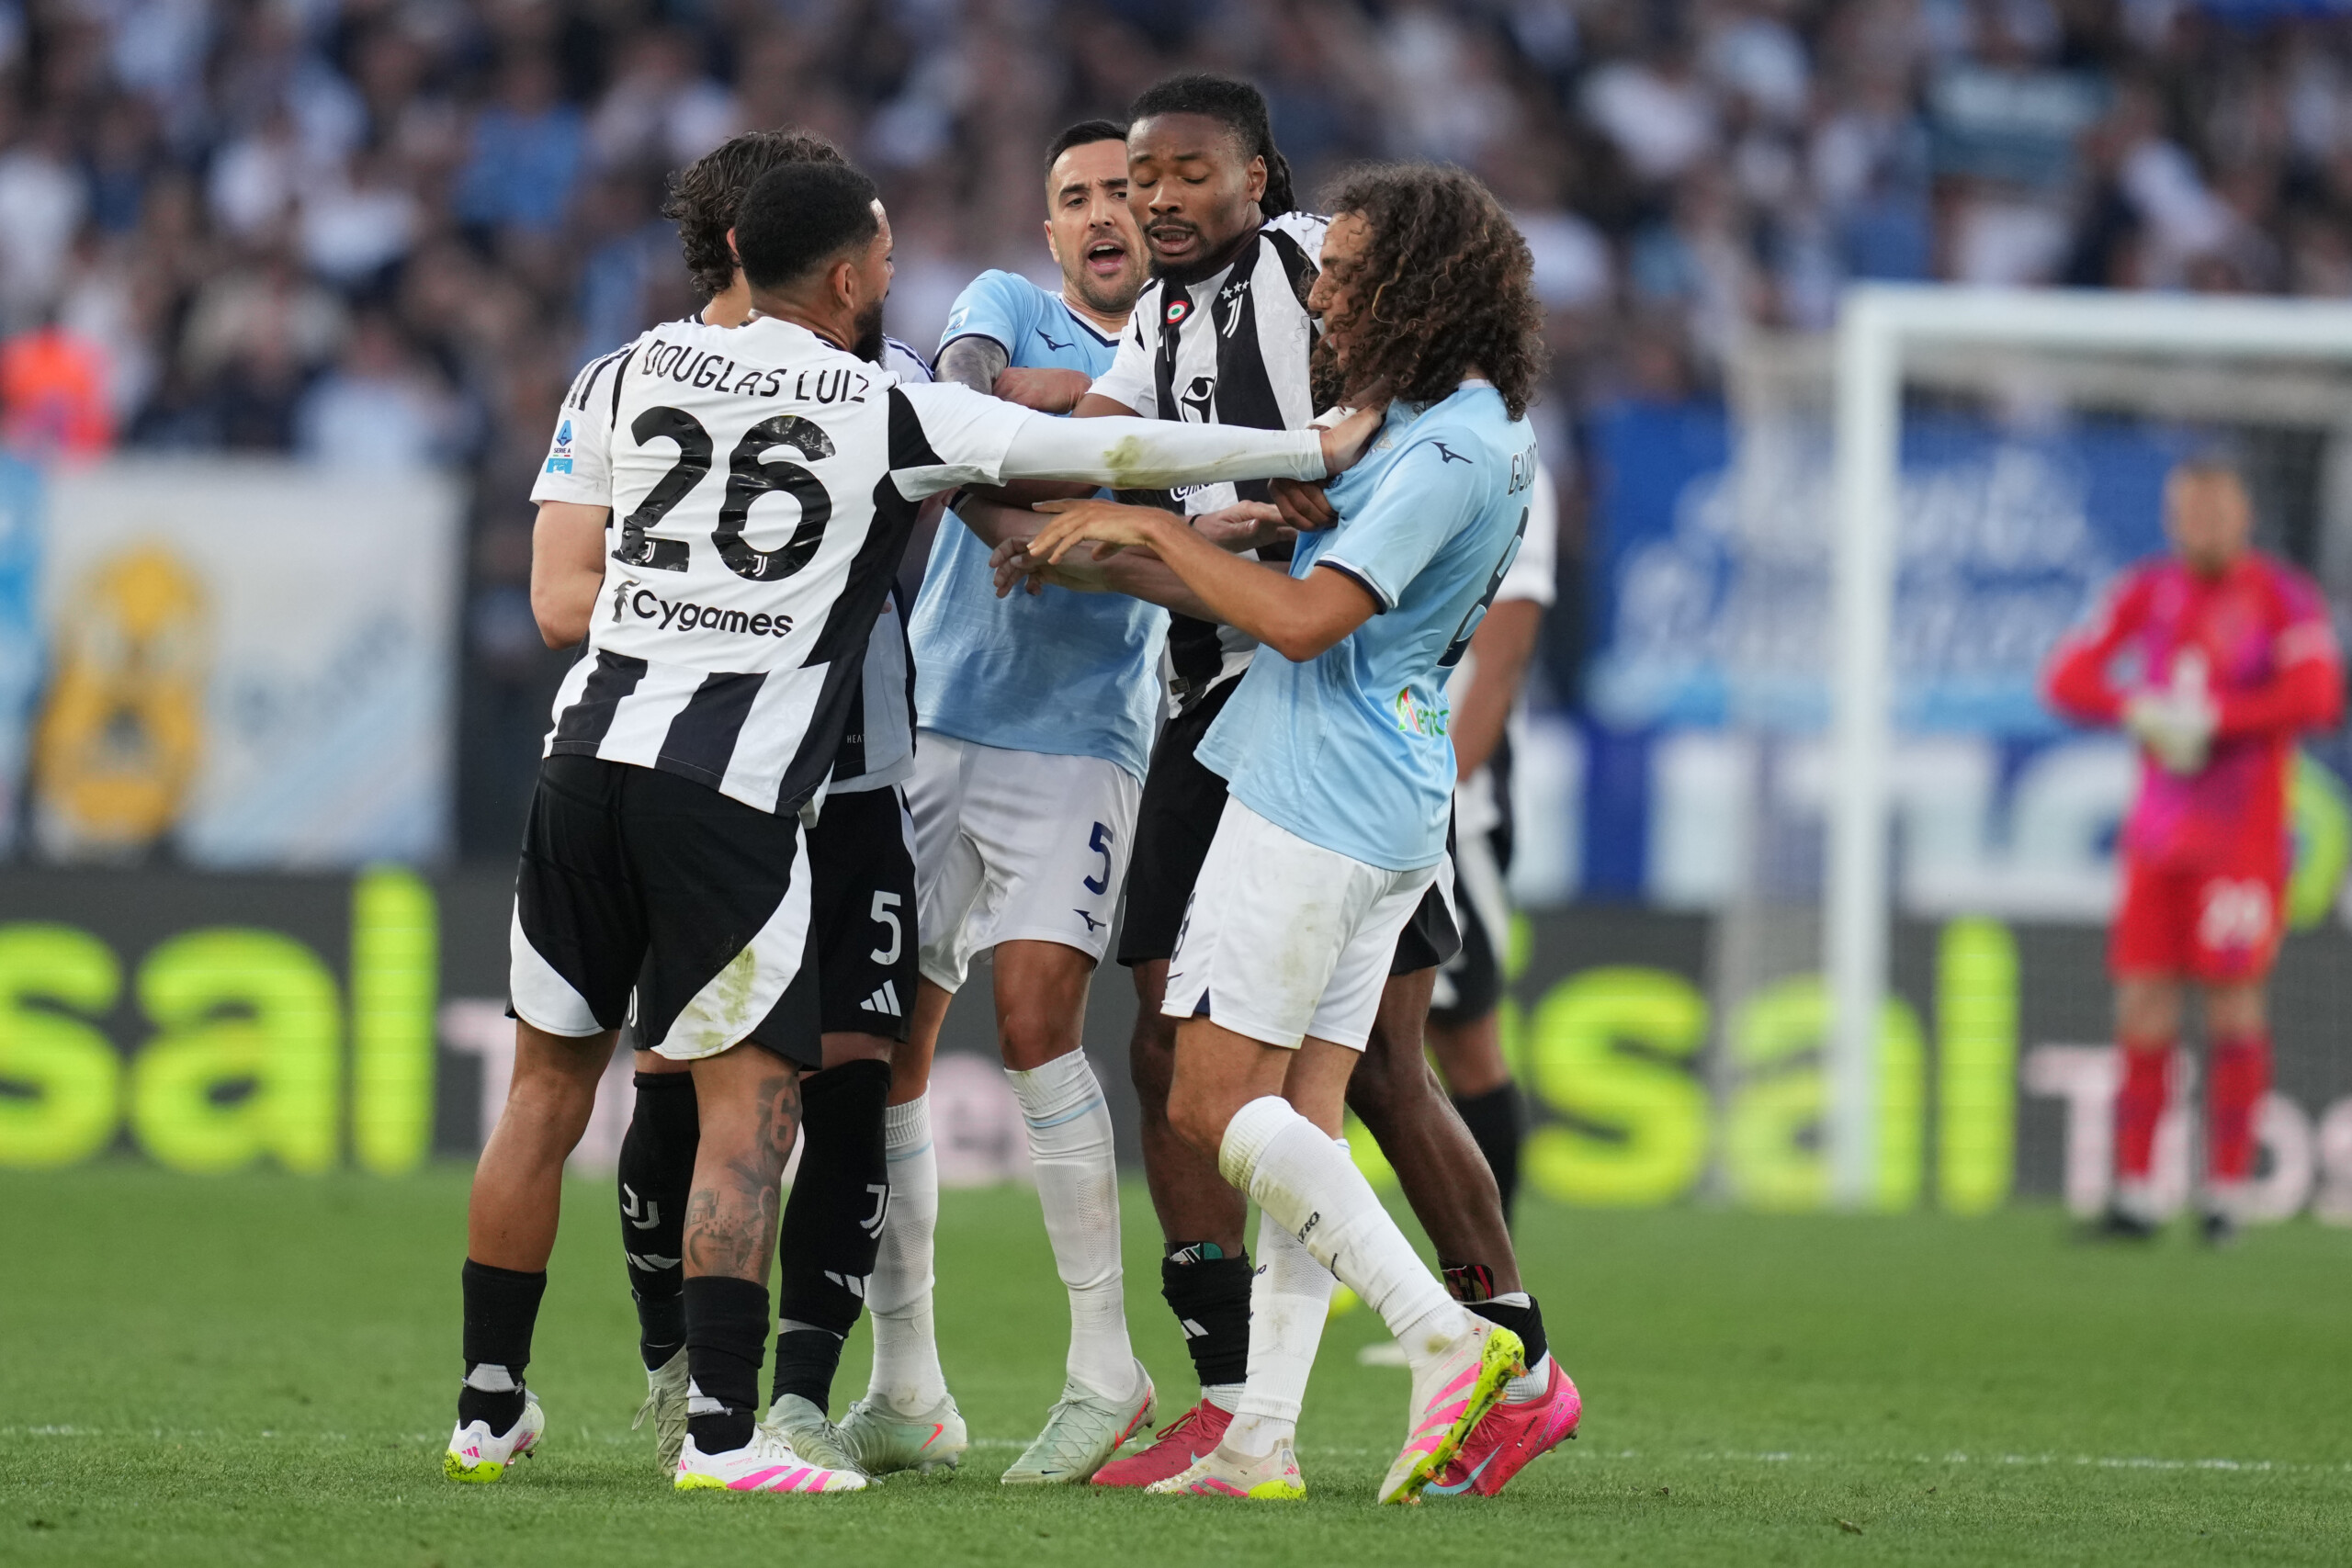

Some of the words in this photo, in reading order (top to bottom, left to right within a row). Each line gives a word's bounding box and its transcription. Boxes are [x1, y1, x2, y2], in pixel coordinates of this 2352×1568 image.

[641, 339, 787, 398] DOUGLAS
[795, 369, 870, 404] LUIZ
[611, 405, 837, 583] 26
[632, 590, 795, 638] Cygames
[1082, 821, 1114, 896] 5
[870, 890, 902, 965] 5
